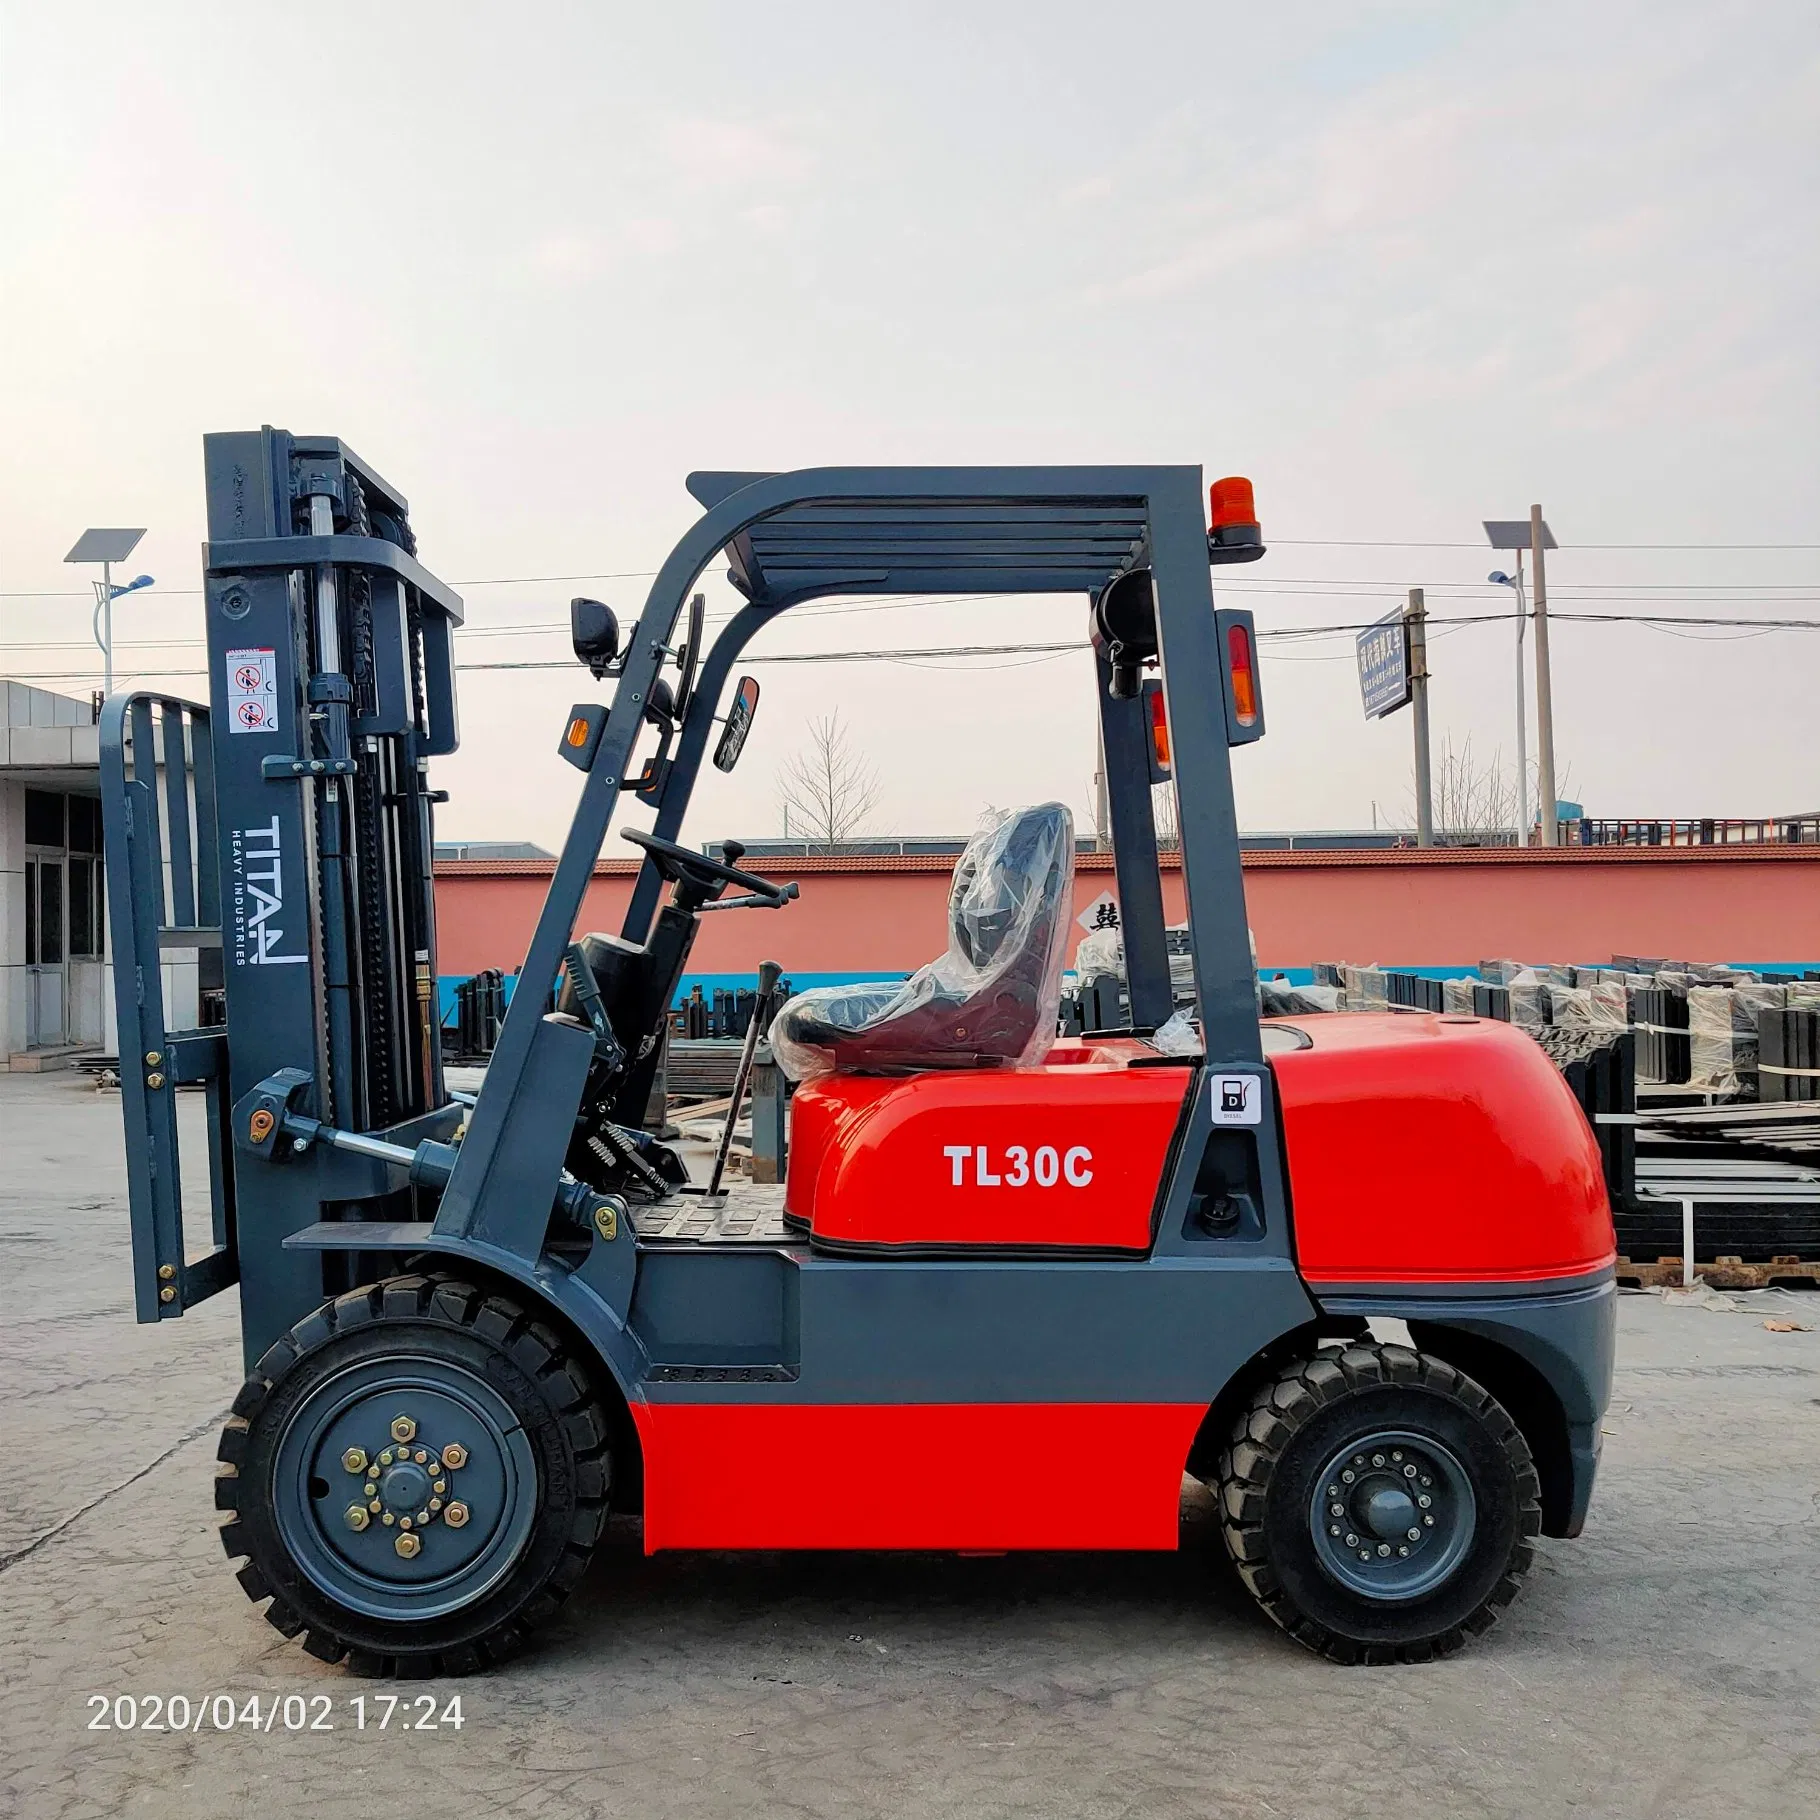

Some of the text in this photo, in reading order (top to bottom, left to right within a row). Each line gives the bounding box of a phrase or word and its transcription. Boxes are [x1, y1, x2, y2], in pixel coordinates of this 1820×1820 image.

[232, 830, 245, 966] HEAVY INDUSTRIES
[245, 815, 308, 964] TITAN
[1229, 1096, 1238, 1107] D
[943, 1145, 1094, 1188] TL30C
